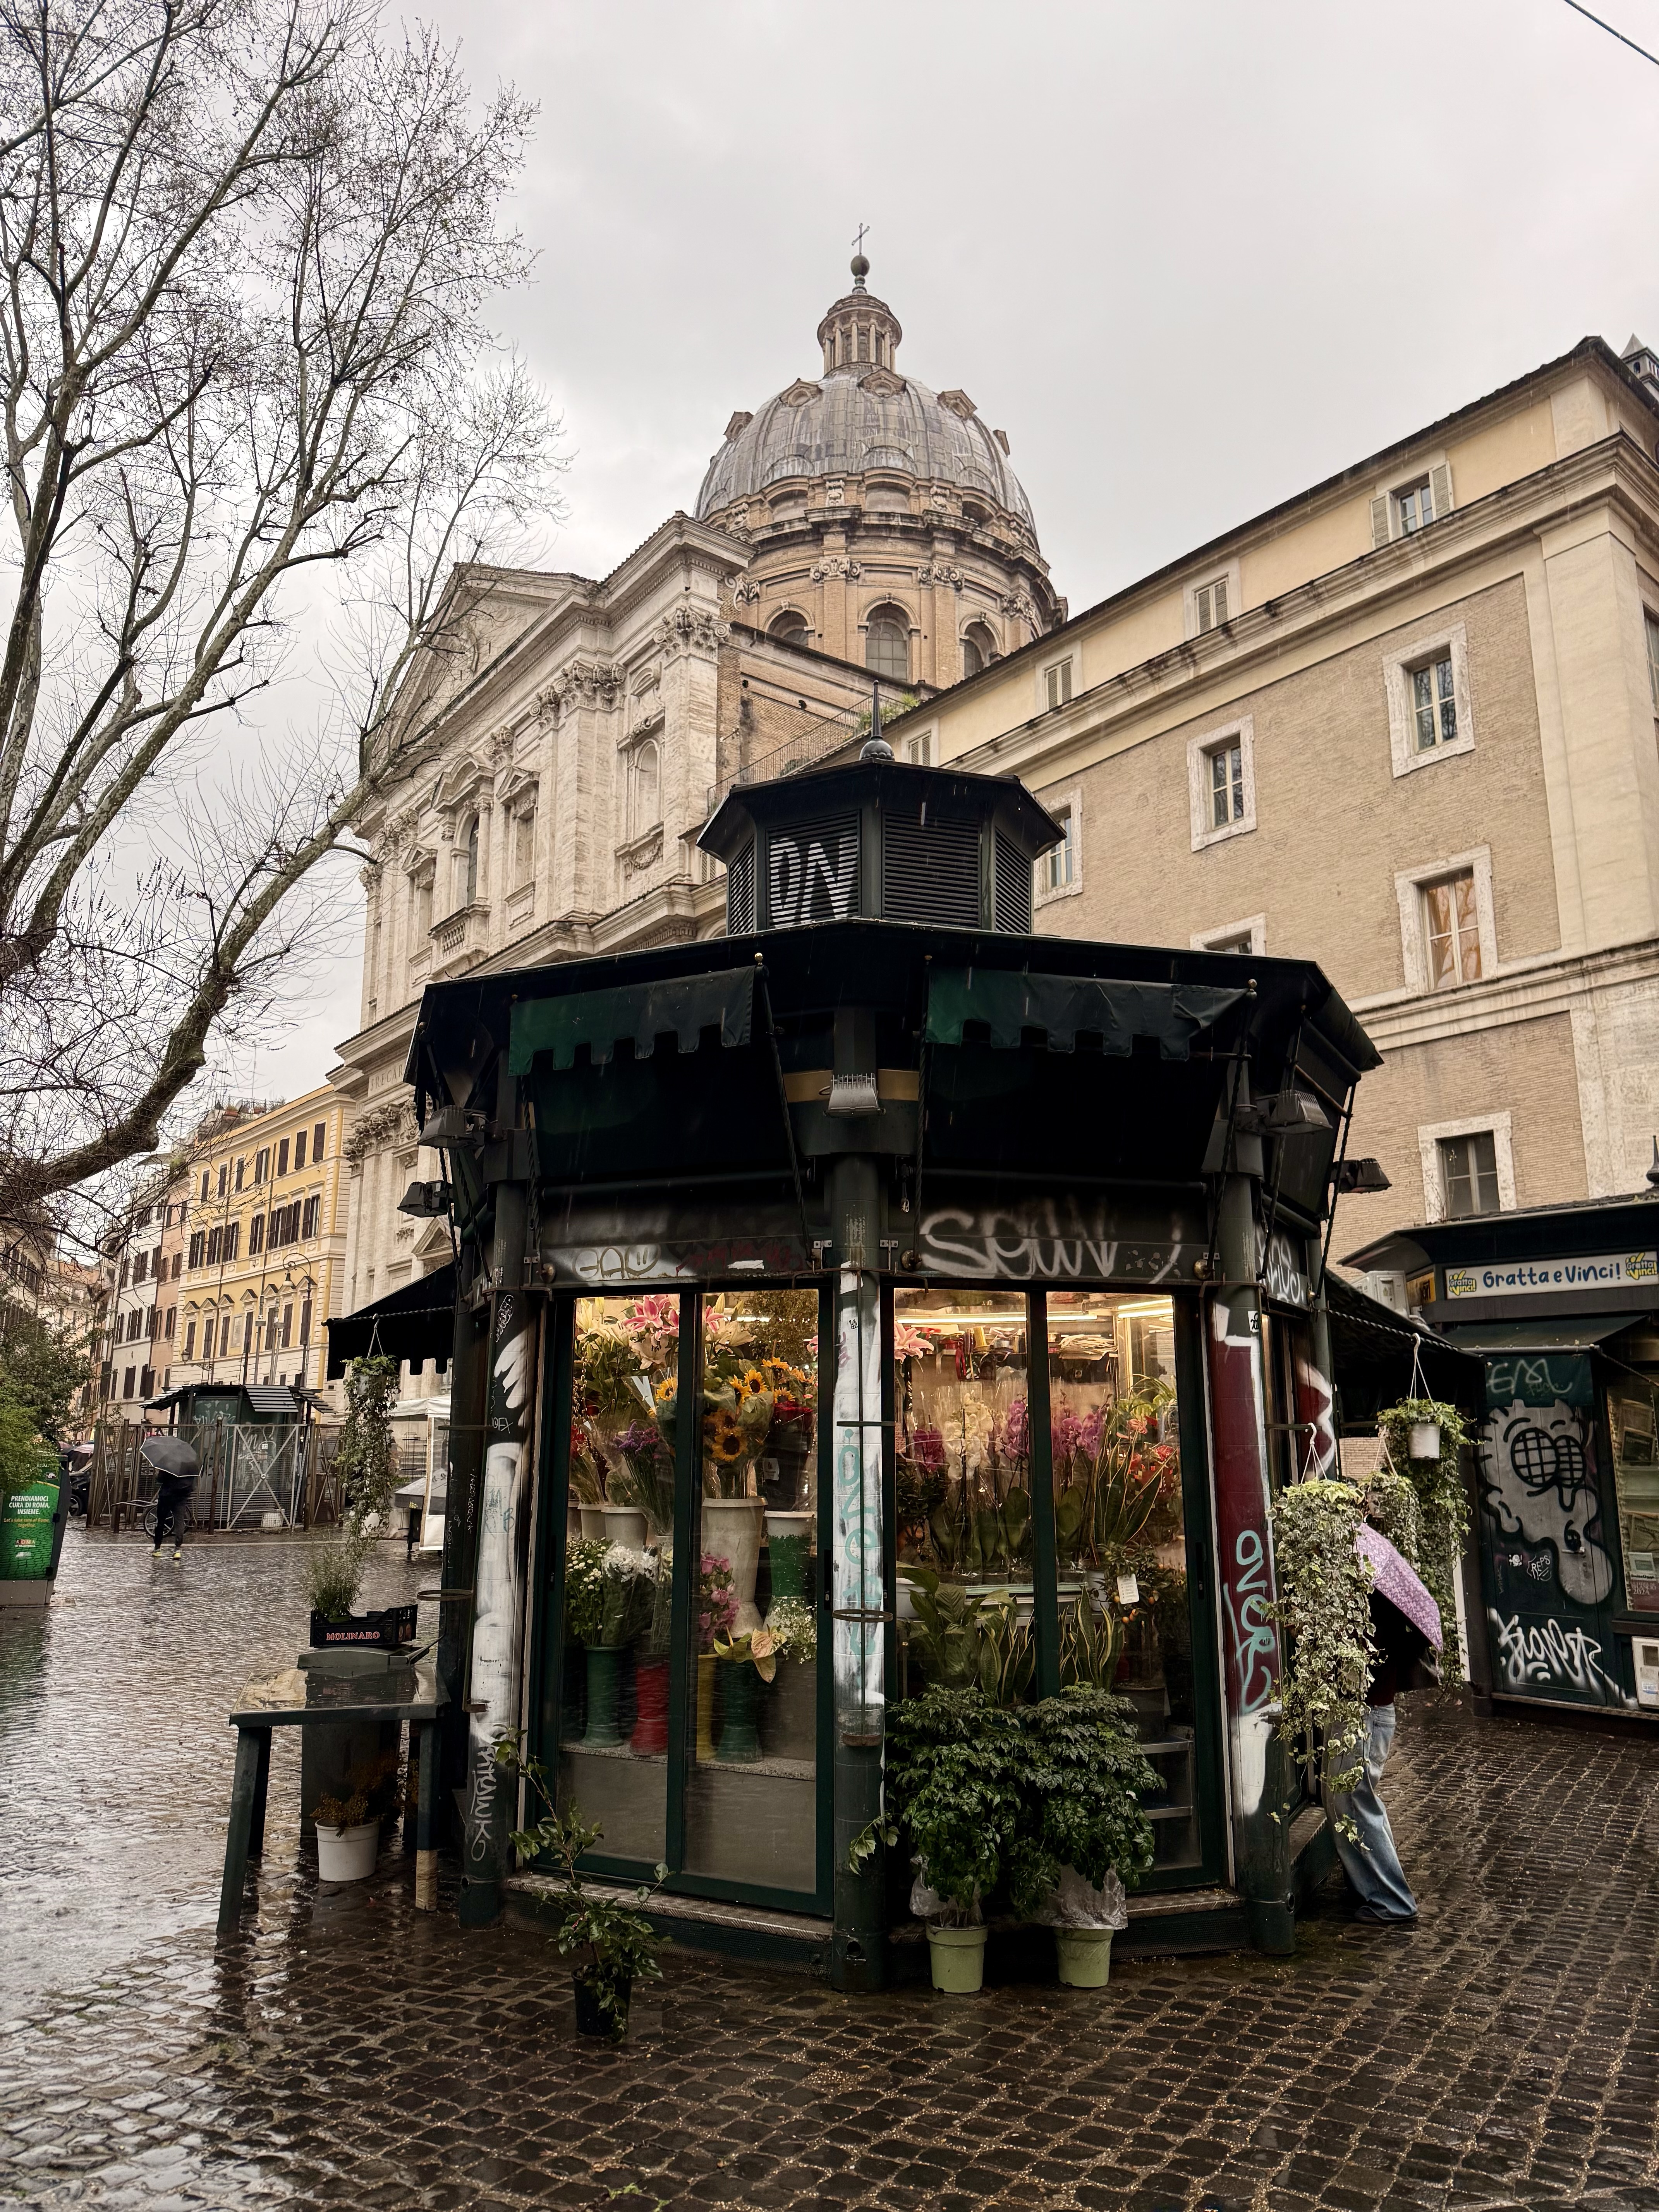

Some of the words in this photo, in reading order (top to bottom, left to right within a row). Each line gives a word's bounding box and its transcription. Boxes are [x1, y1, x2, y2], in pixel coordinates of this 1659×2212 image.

[1627, 1261, 1653, 1269] Gratta
[1483, 1267, 1550, 1288] Gratta
[1553, 1270, 1562, 1283] e
[1565, 1262, 1621, 1283] Vinci!
[1531, 1555, 1551, 1581] REPS
[326, 1631, 380, 1641] MOLINARO
